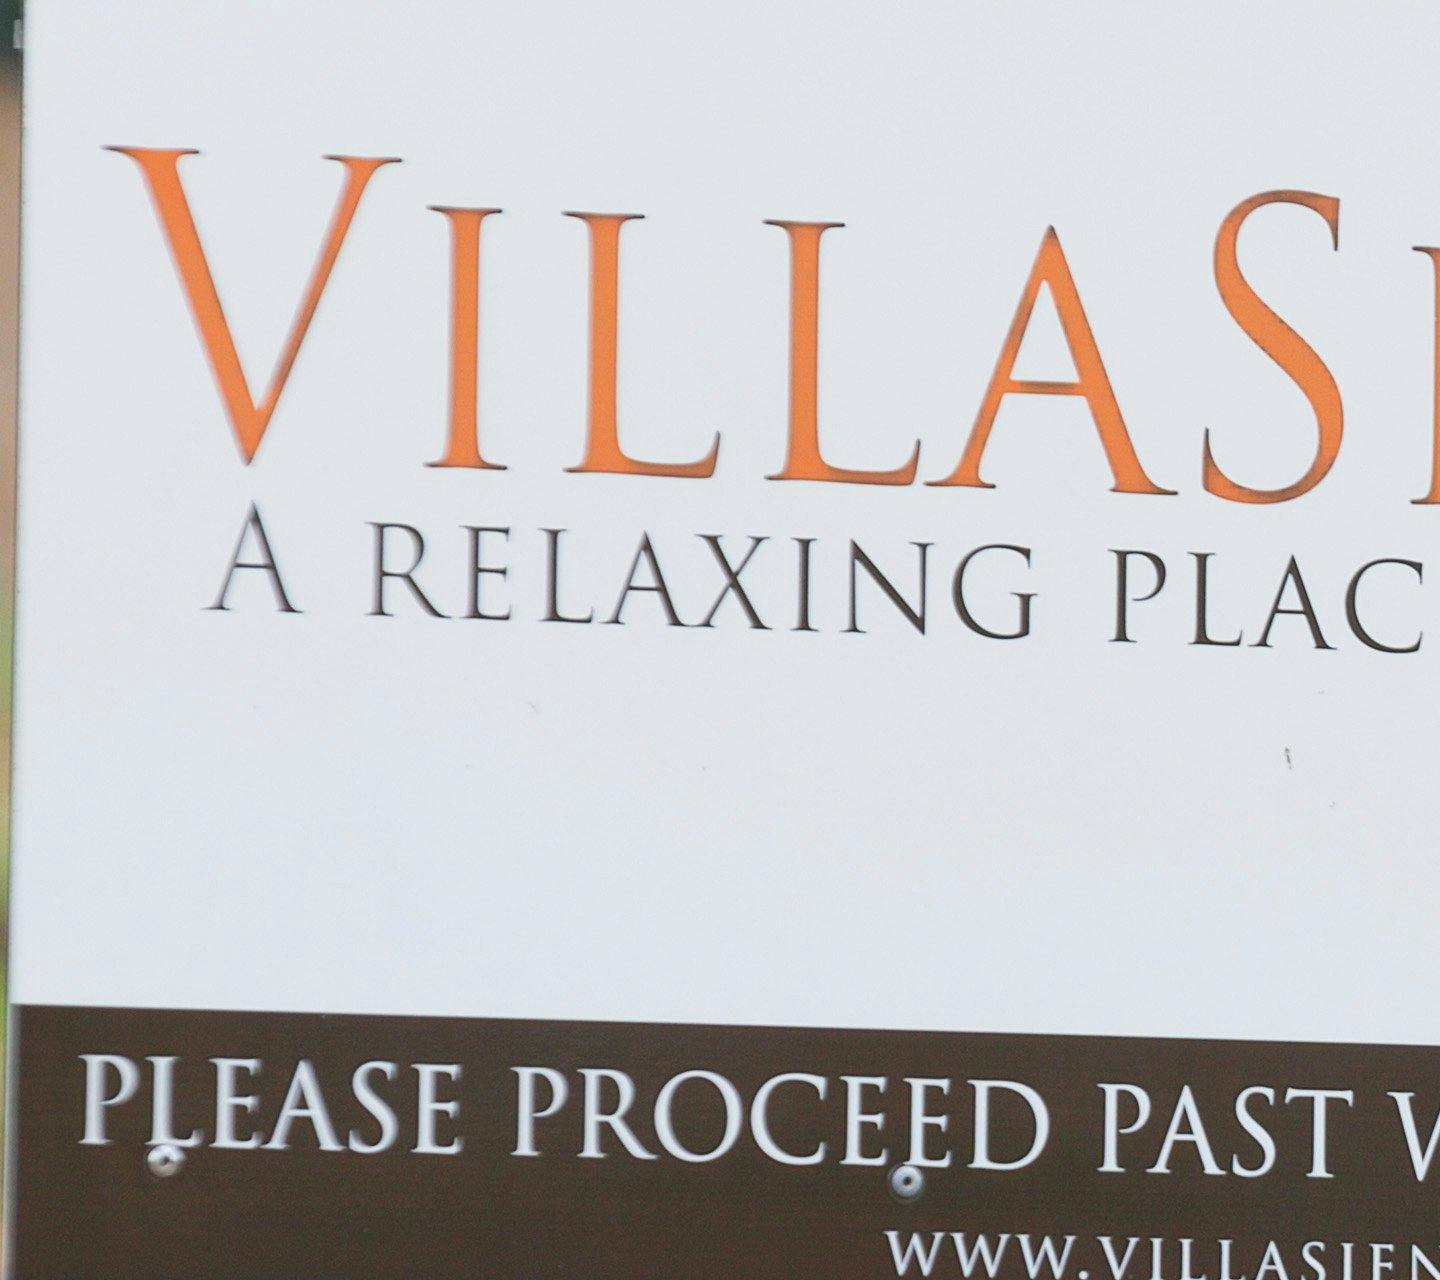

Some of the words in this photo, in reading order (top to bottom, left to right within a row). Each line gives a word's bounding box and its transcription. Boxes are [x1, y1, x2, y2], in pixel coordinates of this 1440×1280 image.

[202, 499, 306, 616] A
[364, 519, 1039, 643] RELAXING
[77, 1053, 465, 1154] PLEASE
[509, 1065, 1051, 1172] PROCEED
[1095, 1082, 1355, 1180] PAST
